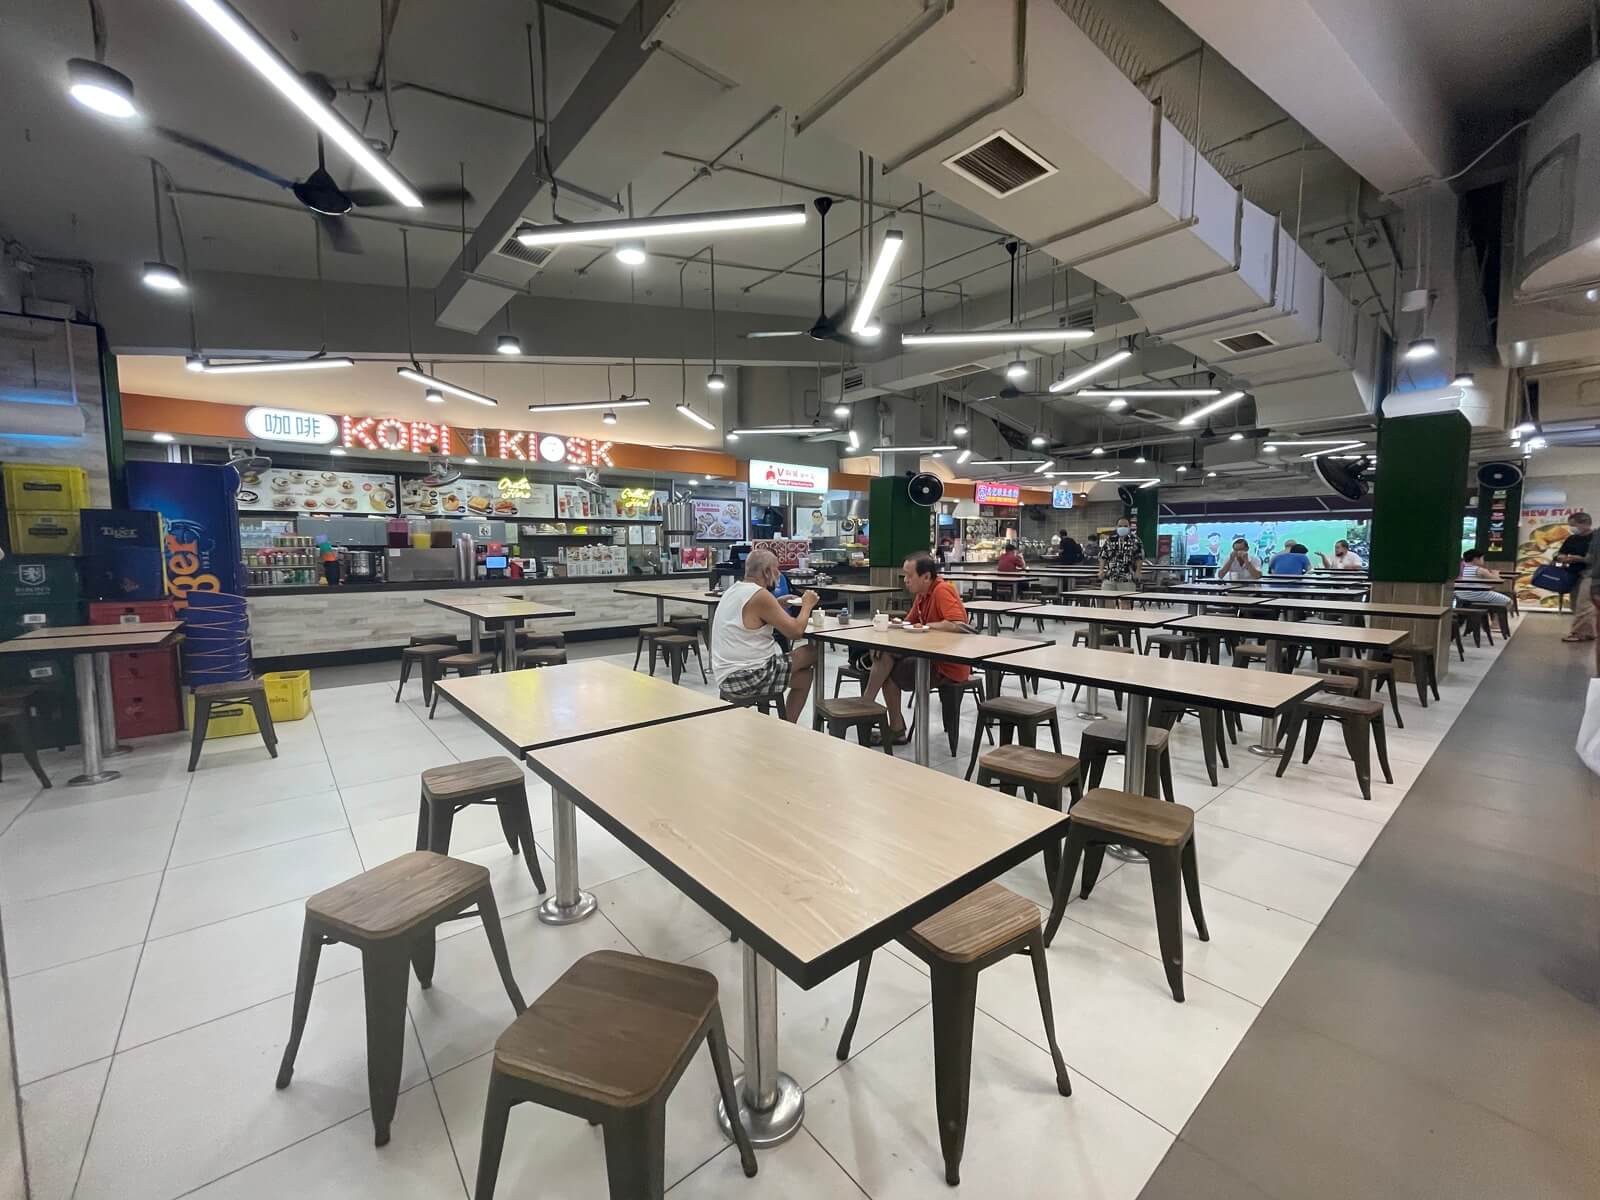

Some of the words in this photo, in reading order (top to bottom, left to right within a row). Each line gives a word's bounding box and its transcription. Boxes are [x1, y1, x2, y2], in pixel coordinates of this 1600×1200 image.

[264, 413, 321, 438] 咖啡
[342, 415, 450, 456] KOPI
[499, 429, 615, 468] KIOSK
[101, 526, 138, 539] Tiger
